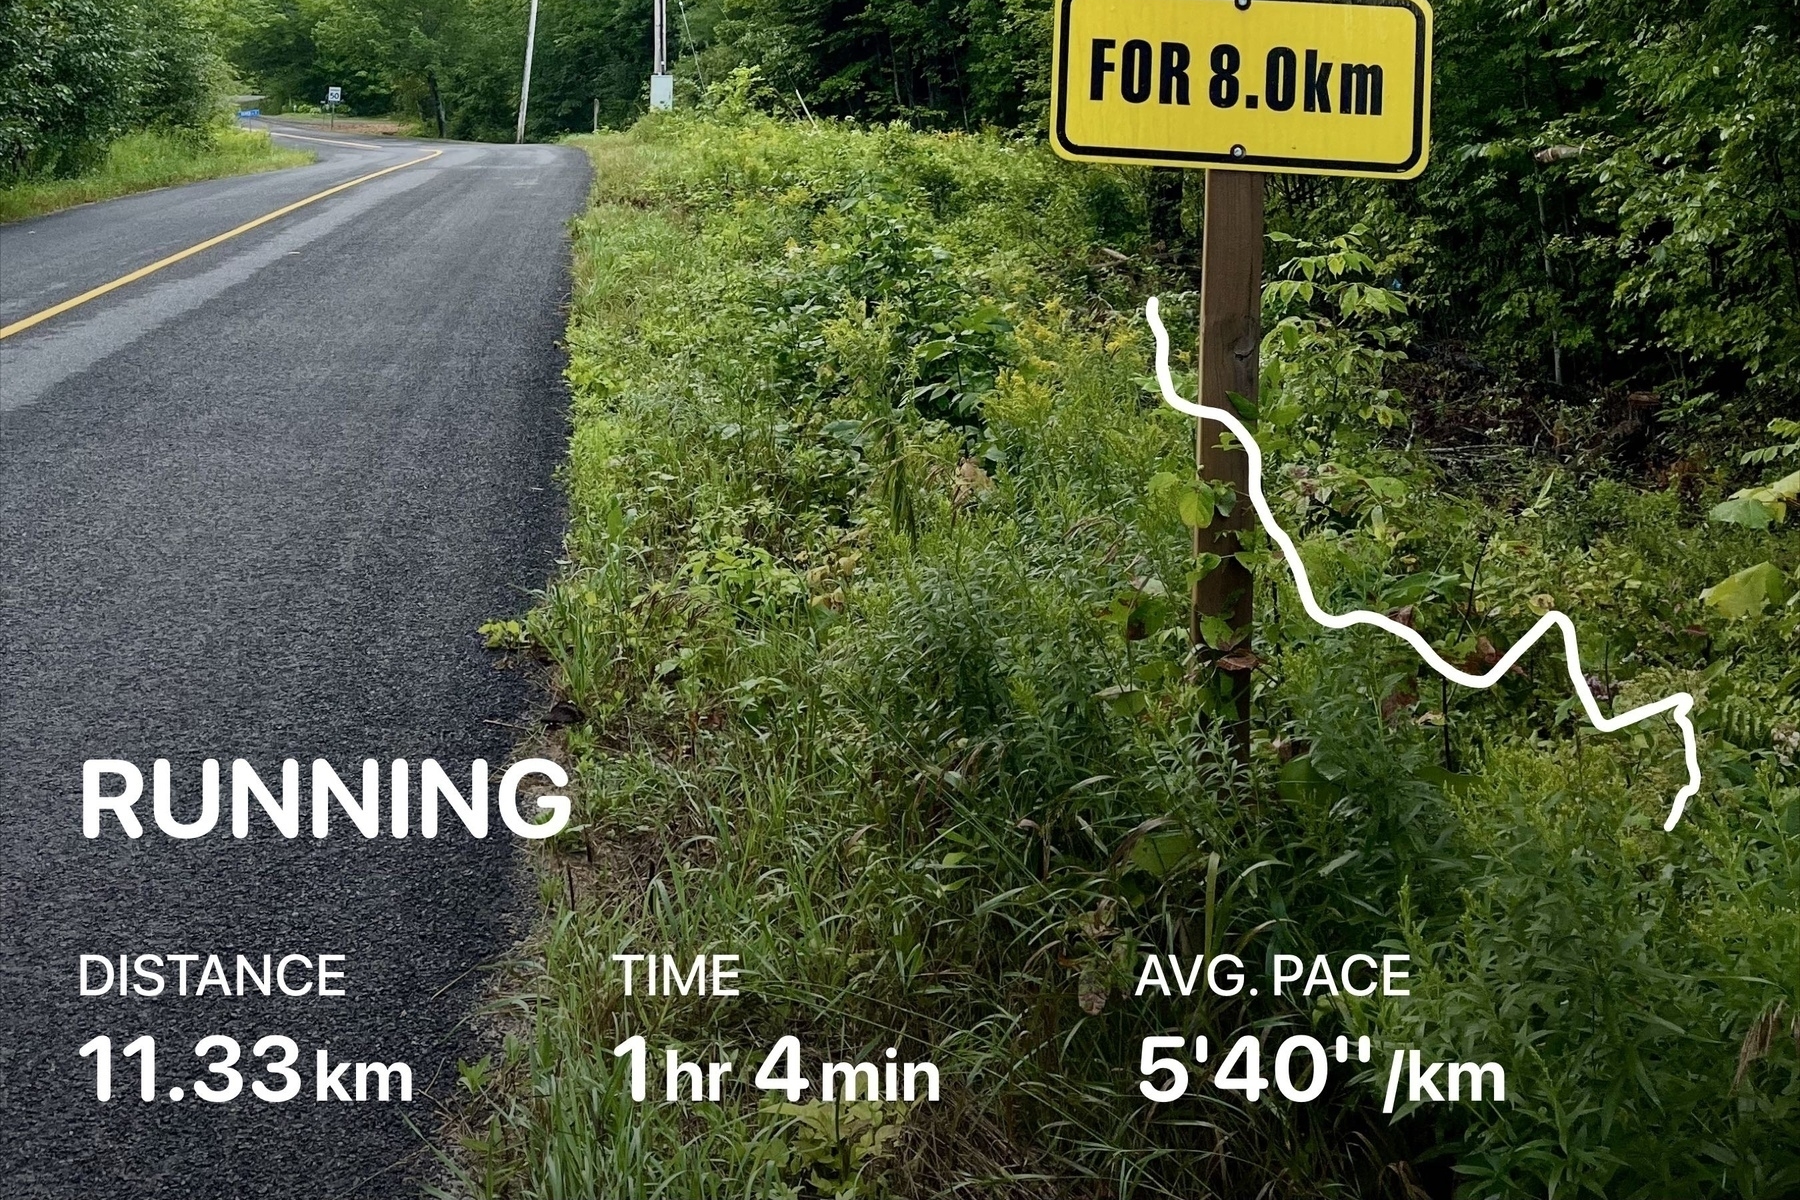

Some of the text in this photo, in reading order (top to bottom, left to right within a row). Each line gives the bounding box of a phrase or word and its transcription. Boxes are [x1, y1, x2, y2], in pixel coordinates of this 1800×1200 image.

[330, 92, 340, 100] 50
[1089, 38, 1384, 116] FOR 8.0km
